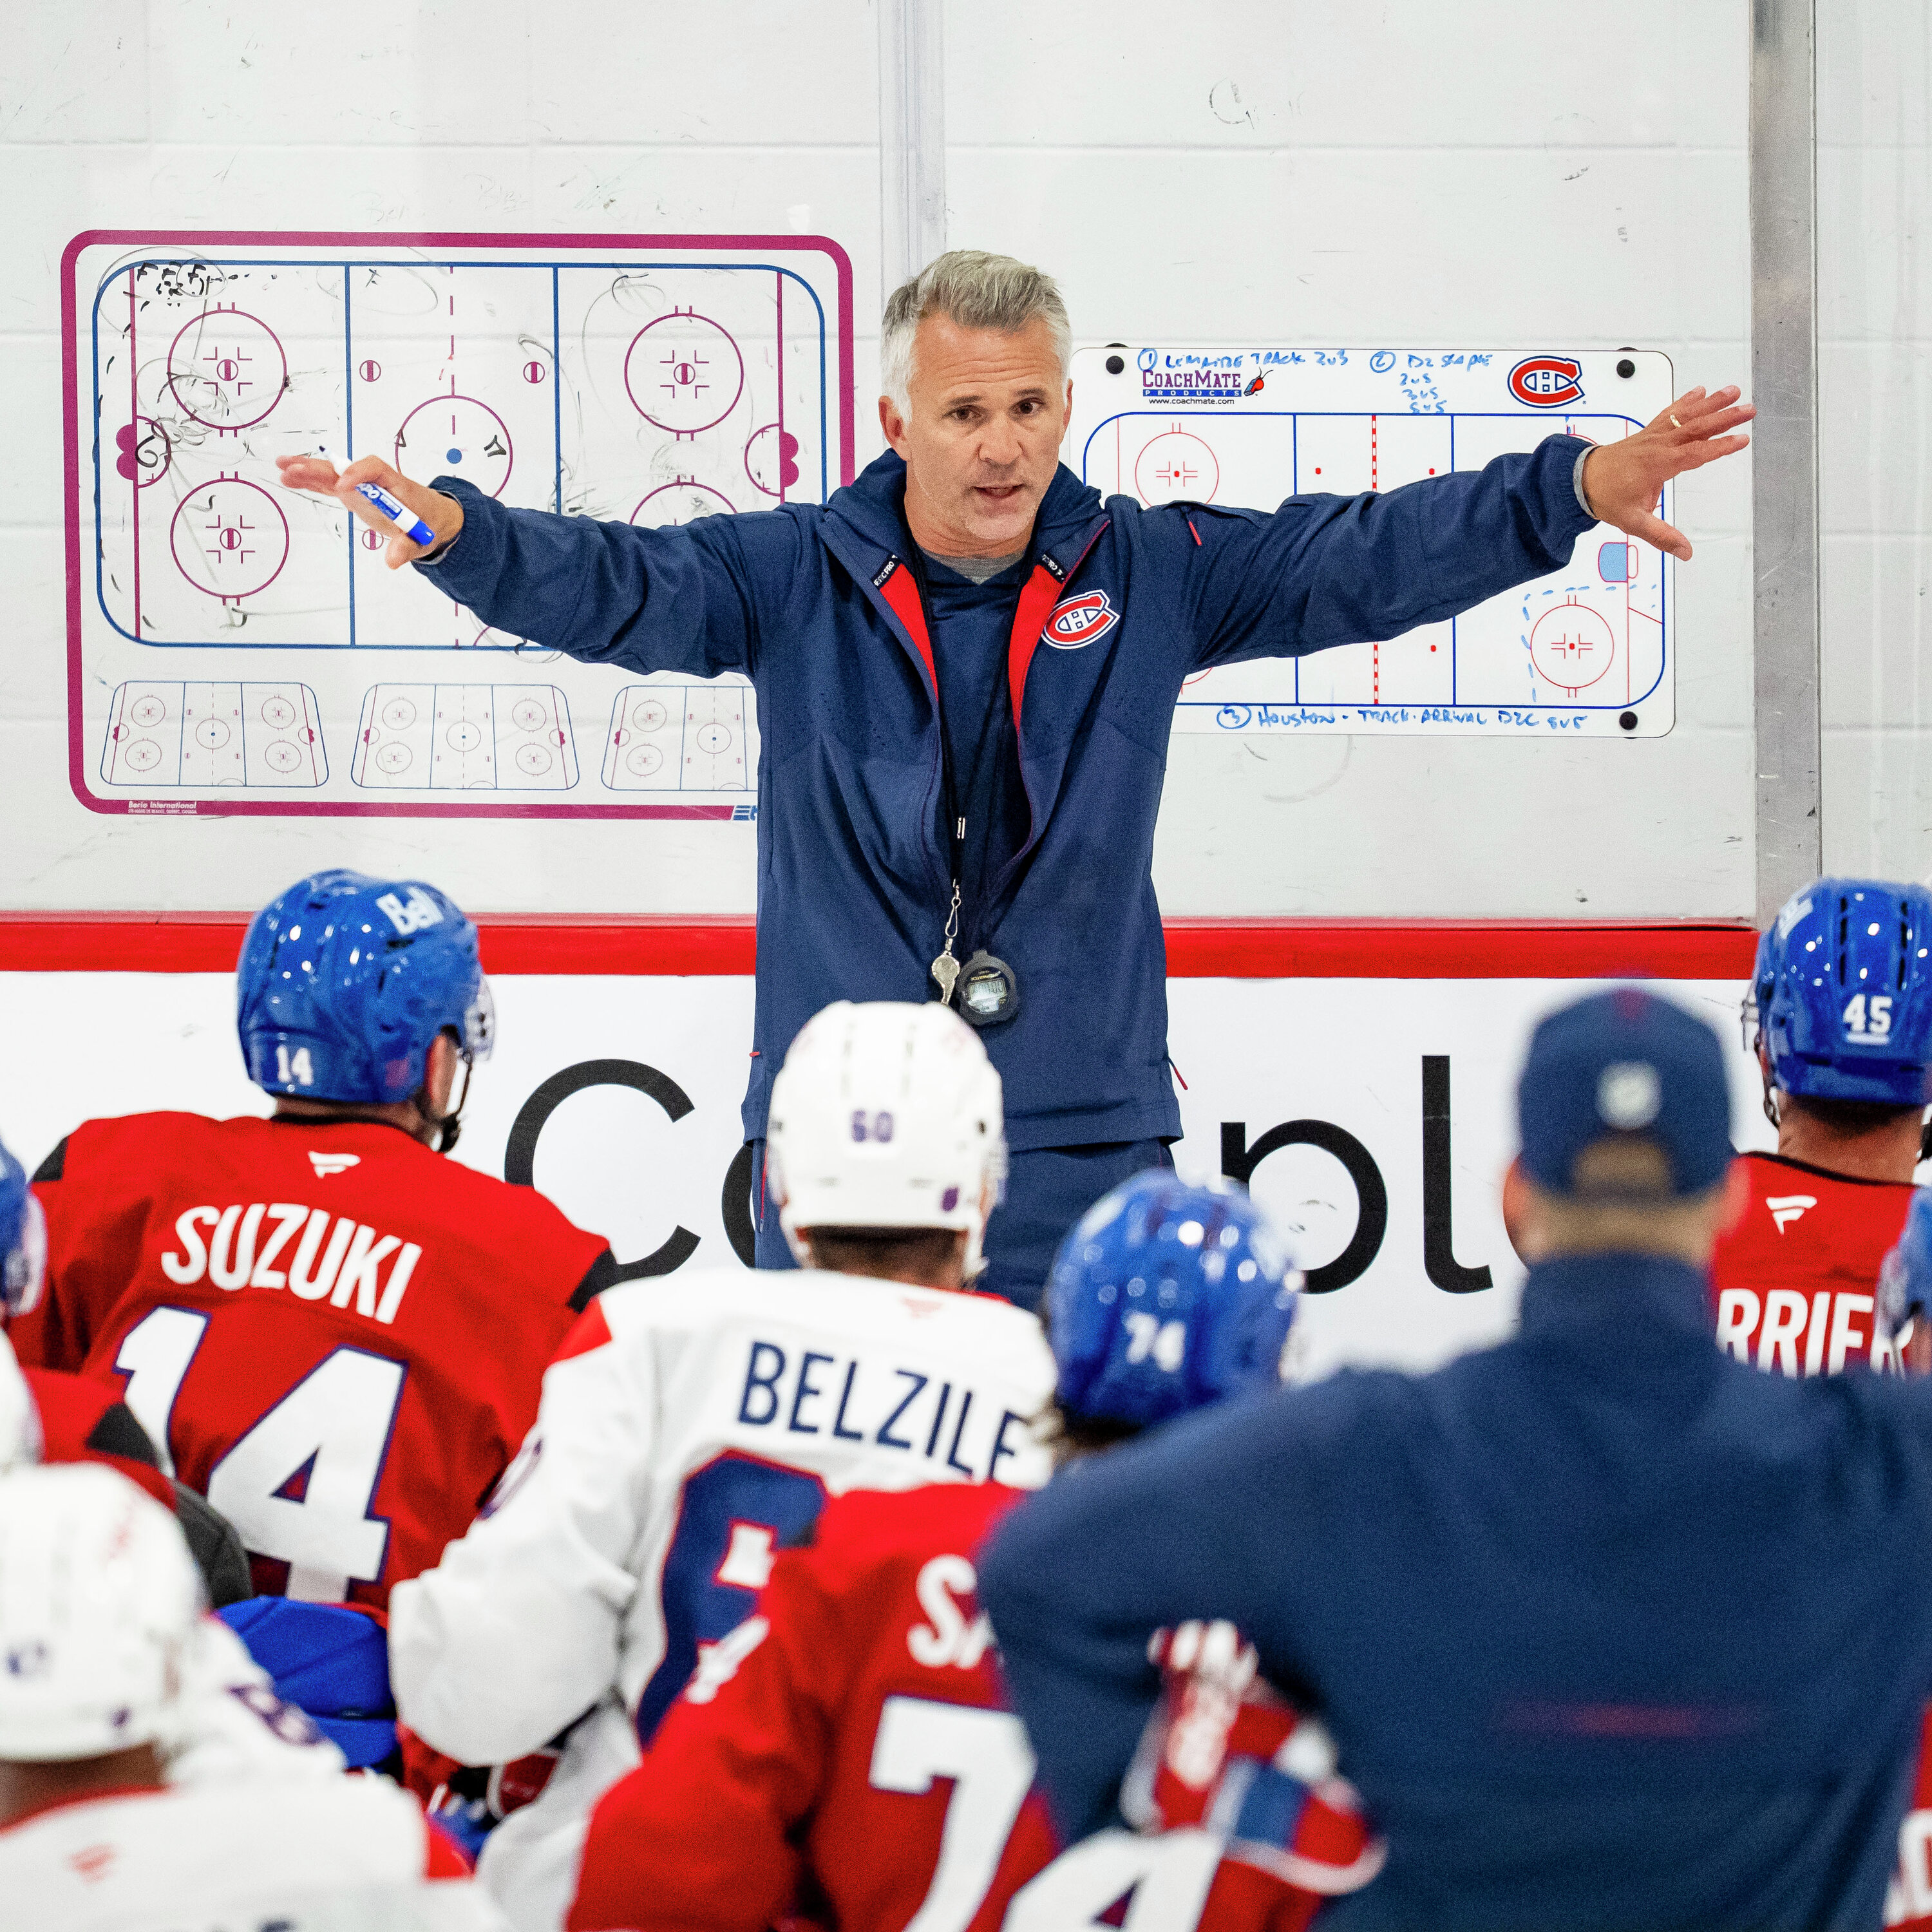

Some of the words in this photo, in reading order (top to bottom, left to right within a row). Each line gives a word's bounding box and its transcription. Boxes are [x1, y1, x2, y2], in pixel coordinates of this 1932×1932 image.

[1842, 994, 1893, 1034] 45
[276, 1045, 314, 1086] 14
[851, 1110, 895, 1144] 60
[160, 1202, 423, 1325] SUZUKI
[112, 1303, 411, 1605] 14
